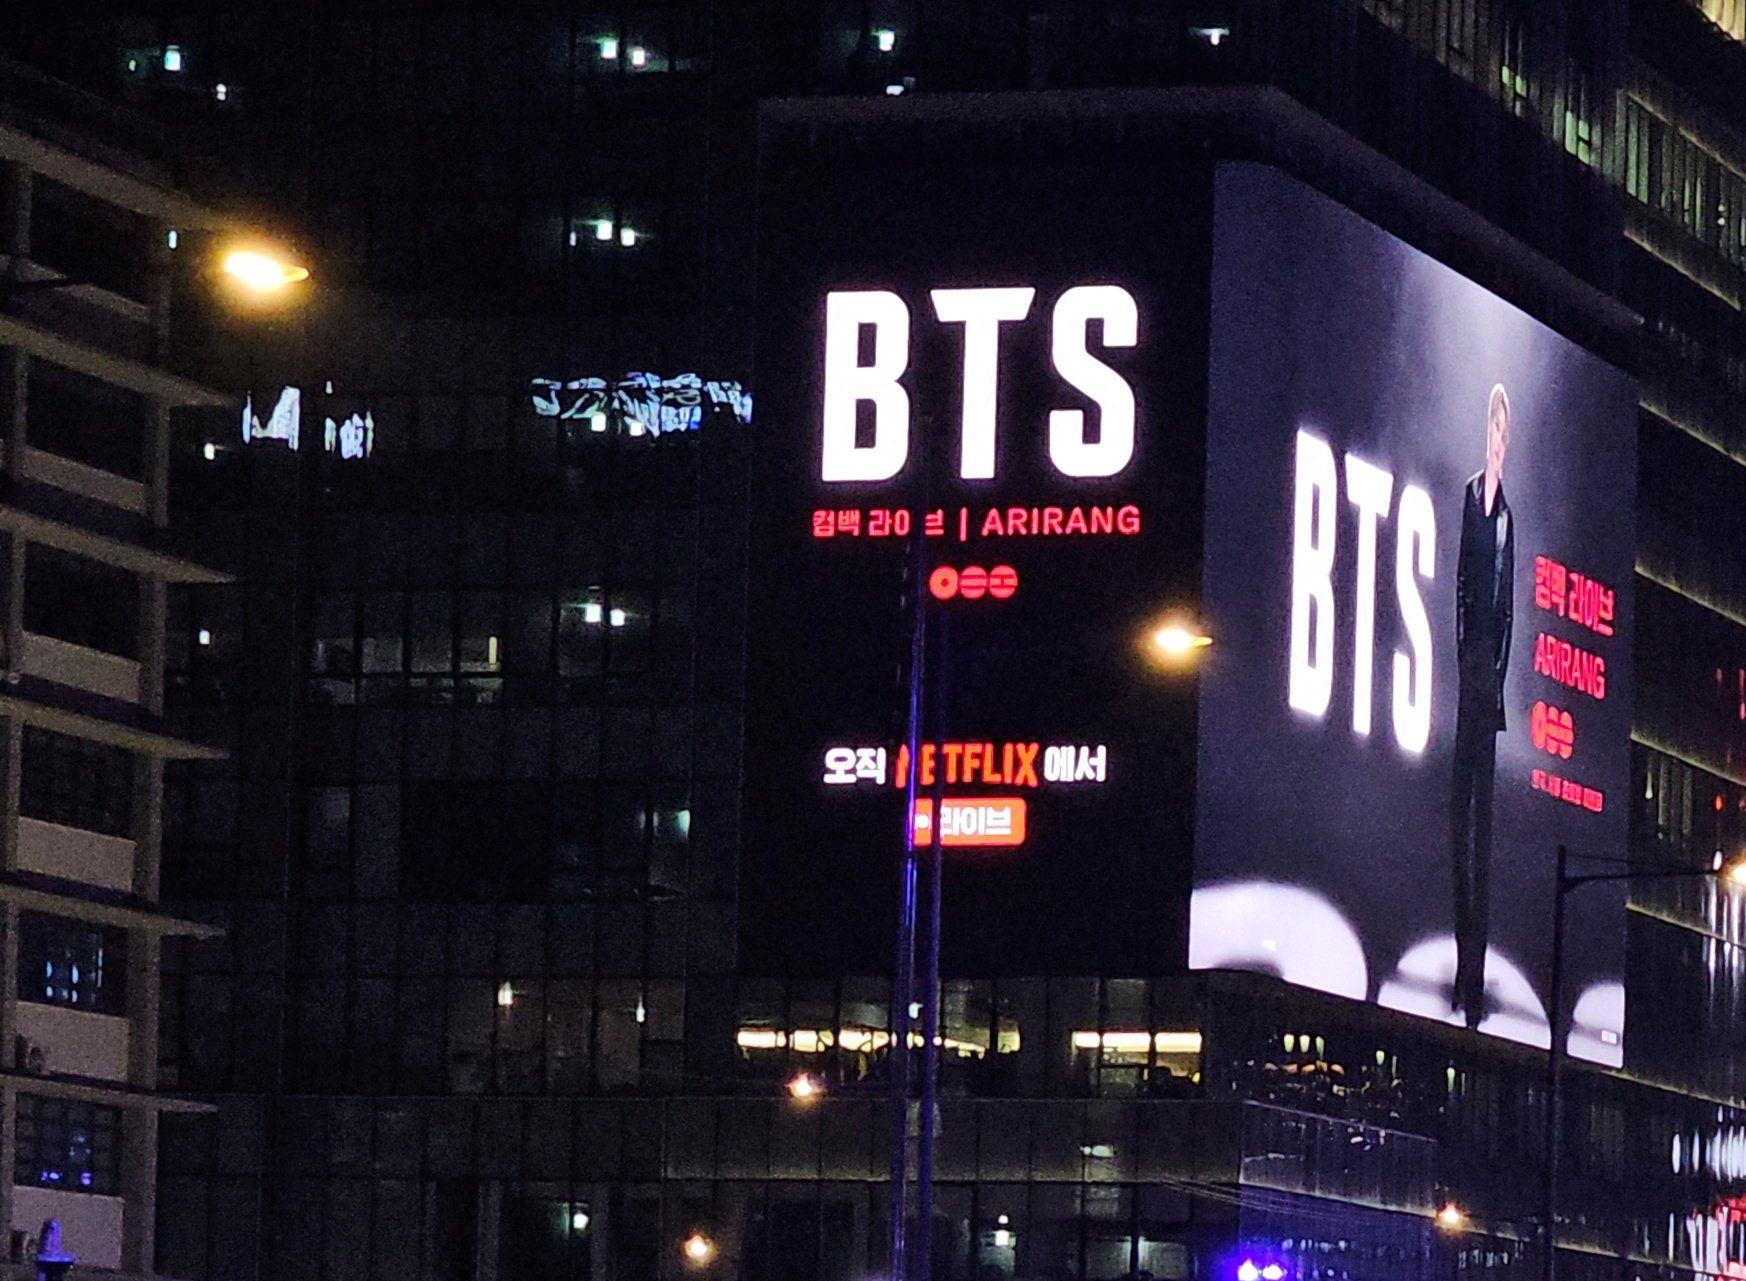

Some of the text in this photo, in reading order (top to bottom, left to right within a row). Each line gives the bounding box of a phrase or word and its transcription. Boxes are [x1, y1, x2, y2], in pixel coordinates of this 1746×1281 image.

[822, 285, 1138, 481] BTS
[812, 509, 861, 538] 컴백
[981, 504, 1141, 537] ARIRANG
[1288, 428, 1437, 754] BTS
[1534, 631, 1605, 699] ARIRANG
[823, 747, 887, 785] 오직
